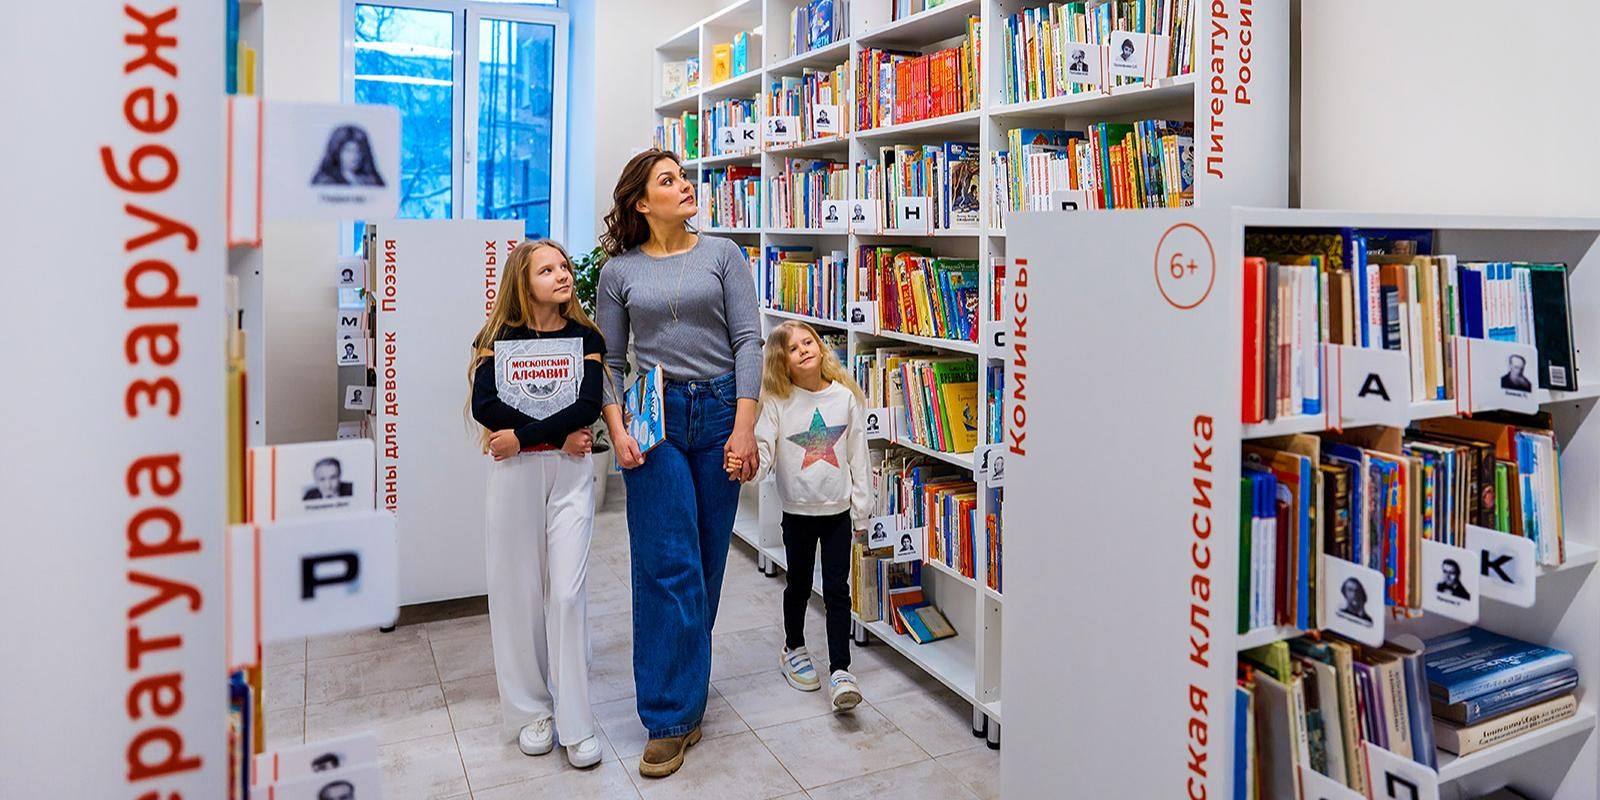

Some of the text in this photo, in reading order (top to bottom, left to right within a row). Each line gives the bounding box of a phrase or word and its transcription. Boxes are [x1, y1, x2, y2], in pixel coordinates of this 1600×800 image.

[1235, 0, 1253, 105] Росси
[743, 130, 754, 140] К
[905, 206, 920, 220] Н
[381, 239, 397, 312] Поэзия
[485, 240, 497, 316] вотных
[1169, 252, 1198, 280] 6+
[341, 316, 358, 327] М
[994, 331, 1006, 347] С
[383, 331, 399, 417] девочек
[512, 356, 570, 369] МОСКОВСКИЙ
[512, 367, 569, 381] АЛФАВИТ
[1008, 257, 1029, 457] Комиксы
[98, 3, 204, 800] ратура зарубеж
[1357, 372, 1392, 402] А
[384, 422, 399, 459] для
[1186, 415, 1215, 670] классика
[301, 552, 361, 600] Р
[1480, 549, 1515, 585] К
